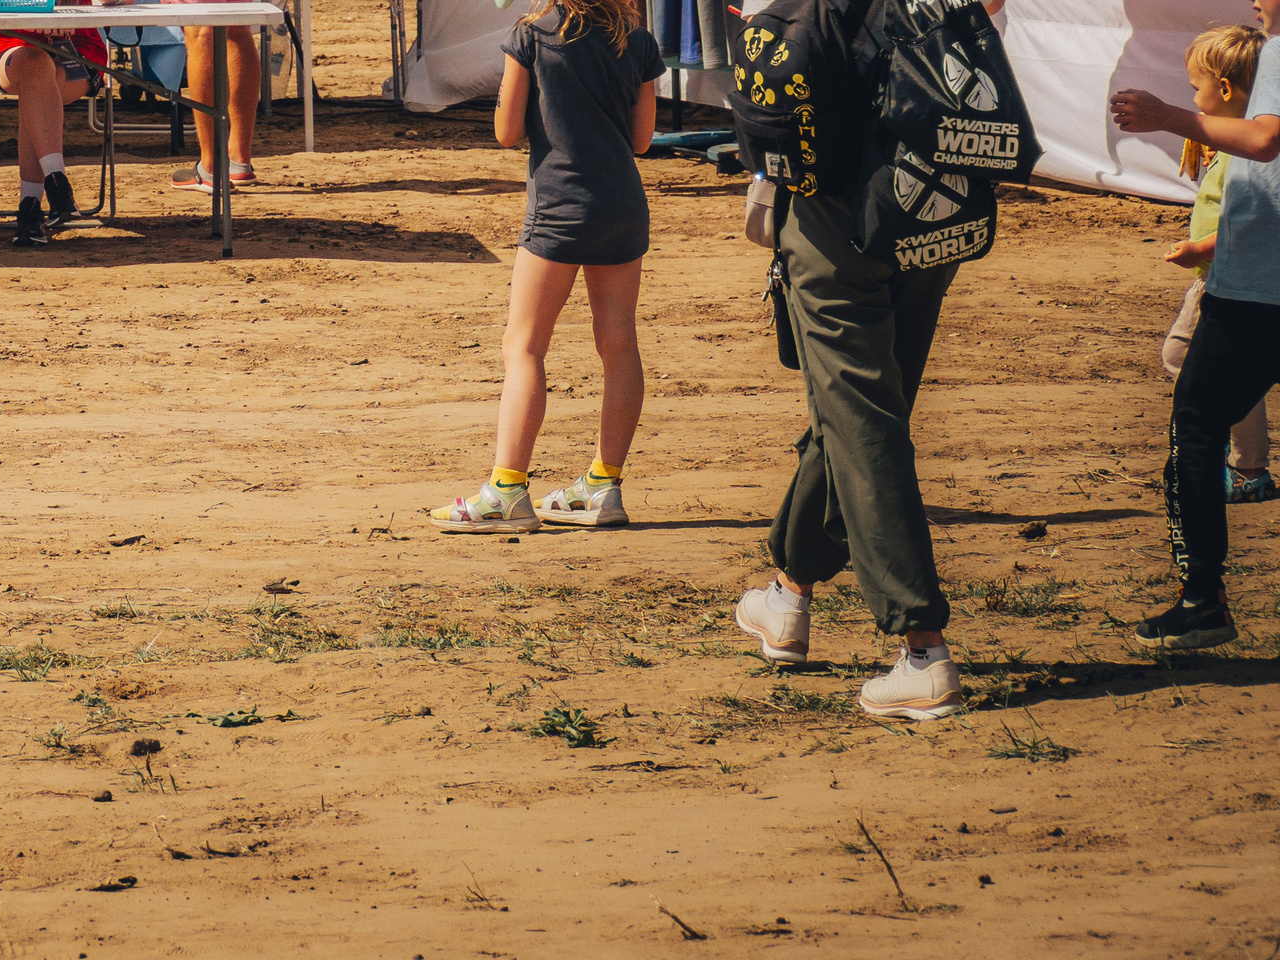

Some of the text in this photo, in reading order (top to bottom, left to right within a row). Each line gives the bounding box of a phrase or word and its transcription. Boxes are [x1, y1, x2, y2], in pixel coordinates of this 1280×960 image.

[936, 129, 1019, 158] WORLD
[933, 151, 1018, 170] CHAMPIONSHIP
[894, 226, 988, 266] WORLD
